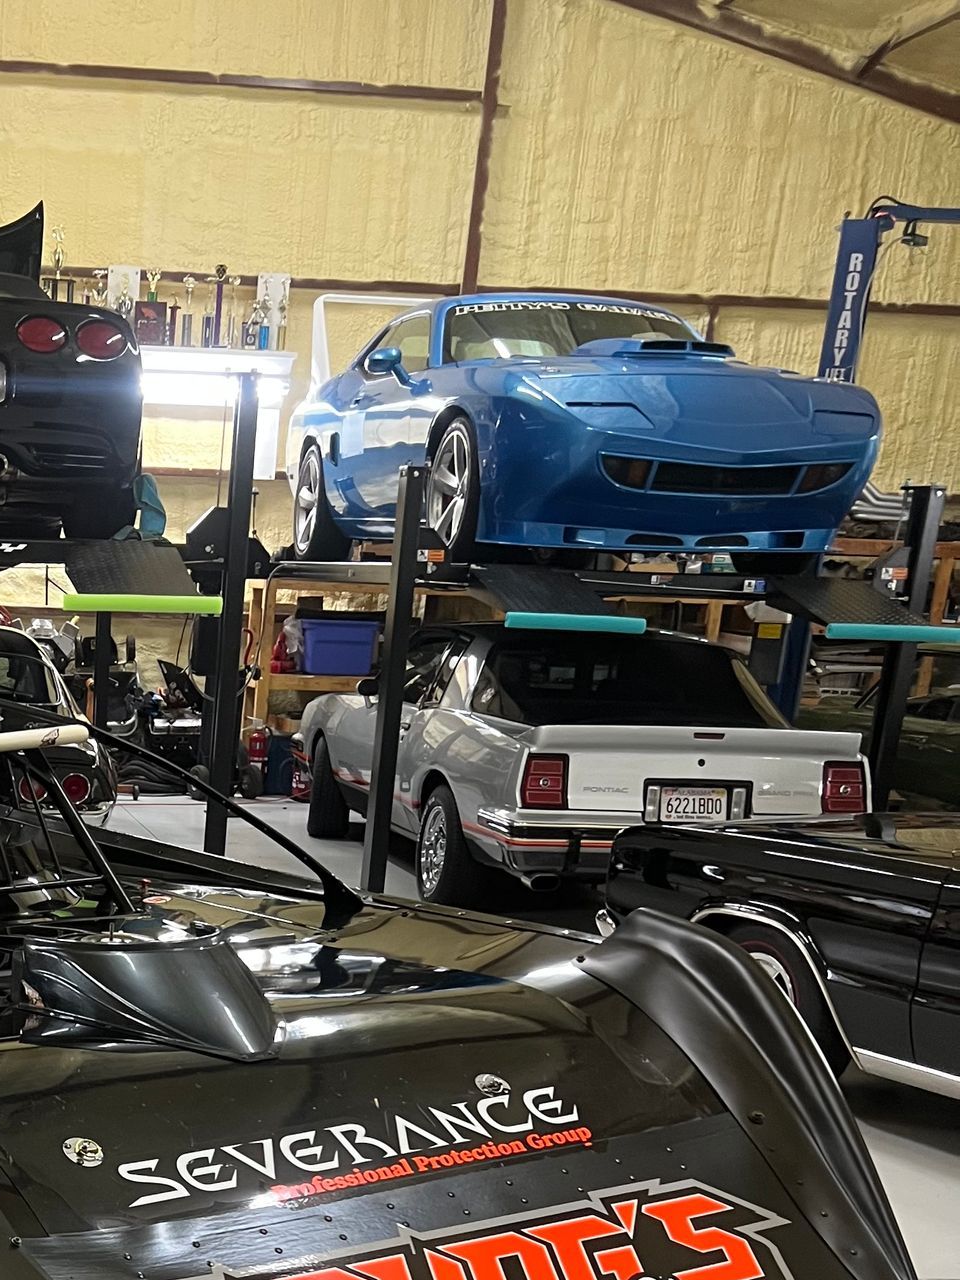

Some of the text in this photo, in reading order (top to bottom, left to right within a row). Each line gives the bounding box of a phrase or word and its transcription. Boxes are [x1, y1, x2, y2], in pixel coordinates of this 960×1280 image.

[834, 253, 863, 366] ROTARY
[583, 786, 629, 794] PONTIAC
[118, 1086, 579, 1208] SEVERANCE
[269, 1125, 593, 1199] Professional Protection Group
